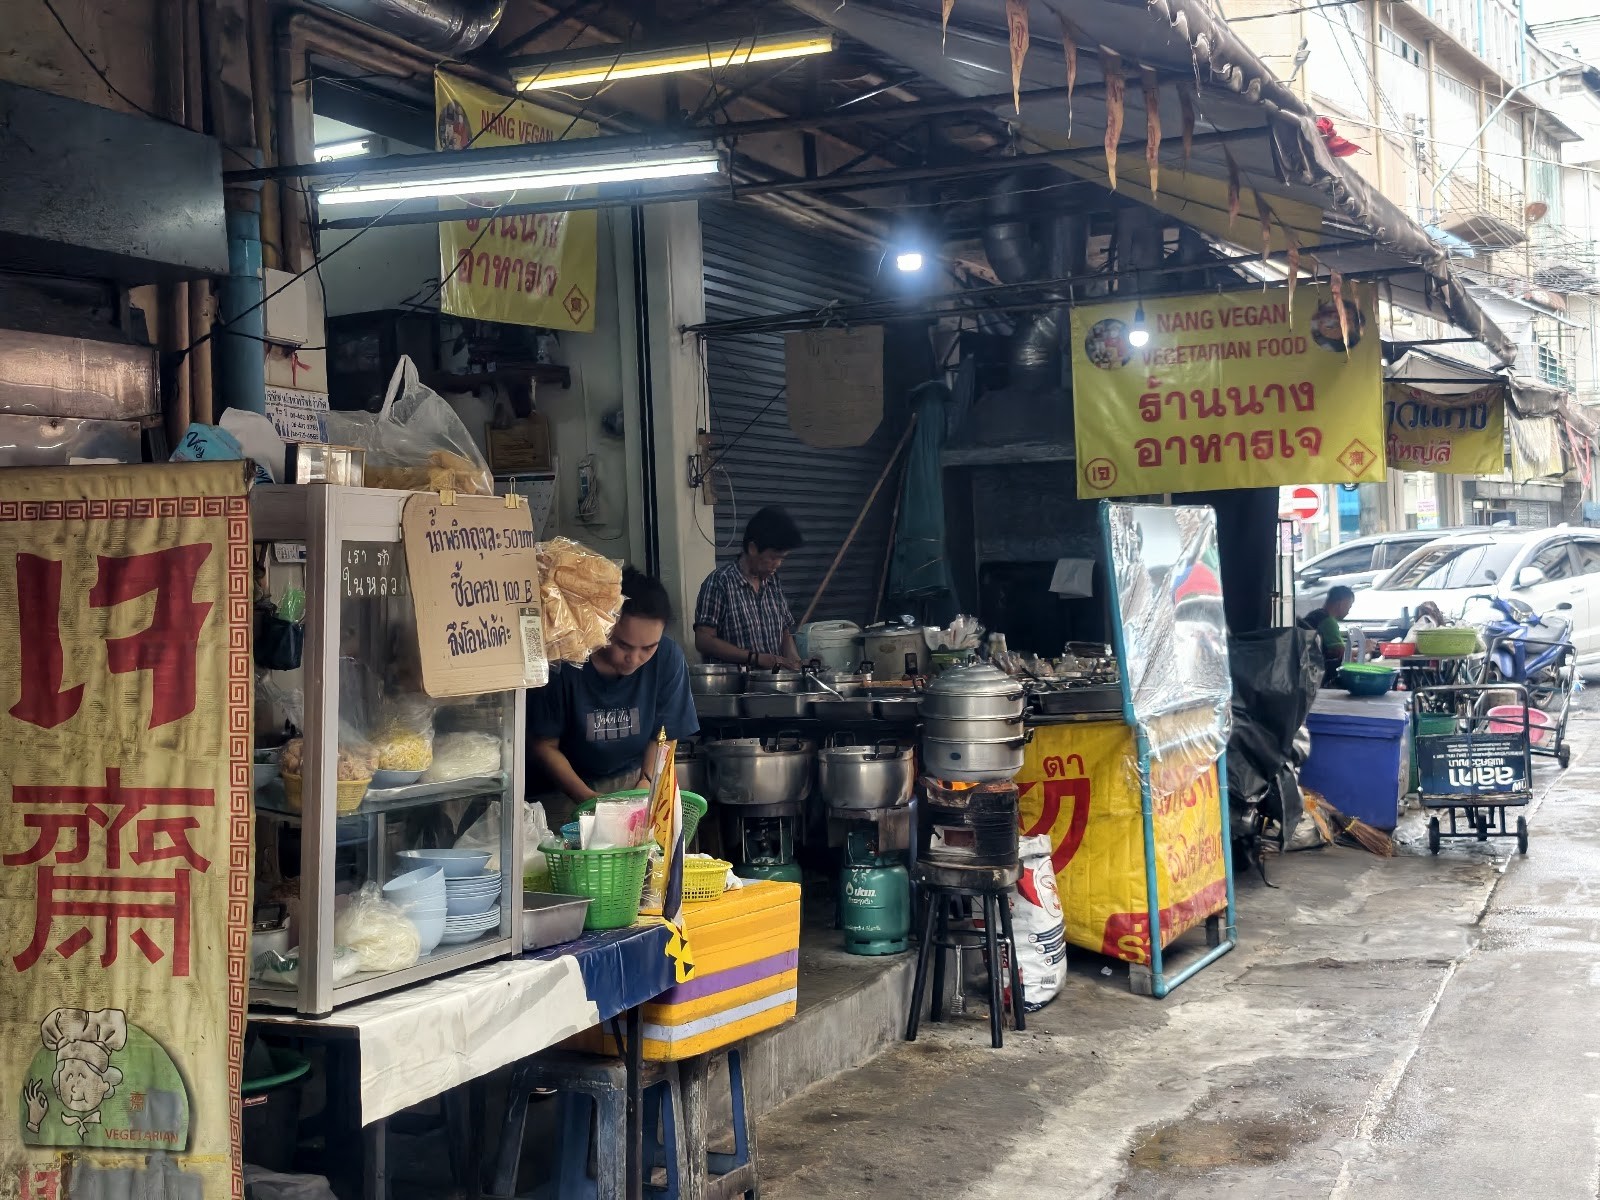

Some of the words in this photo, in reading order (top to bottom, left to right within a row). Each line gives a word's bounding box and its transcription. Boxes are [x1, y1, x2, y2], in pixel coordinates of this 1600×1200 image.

[481, 110, 515, 139] NANG
[457, 248, 558, 297] อาหารเจ
[1157, 310, 1214, 333] NANG
[1218, 303, 1287, 328] VEGAN
[1141, 340, 1250, 366] VEGETARIAN
[1257, 336, 1307, 357] FOOD
[1138, 375, 1315, 423] ร้านนาง
[1134, 426, 1323, 468] อาหารเจ
[347, 550, 367, 565] เรา
[377, 549, 390, 566] รัก
[342, 566, 400, 597] ในหลว
[503, 581, 520, 602] 100
[8, 542, 215, 731] เจ
[105, 1128, 180, 1144] VEGETARIAN
